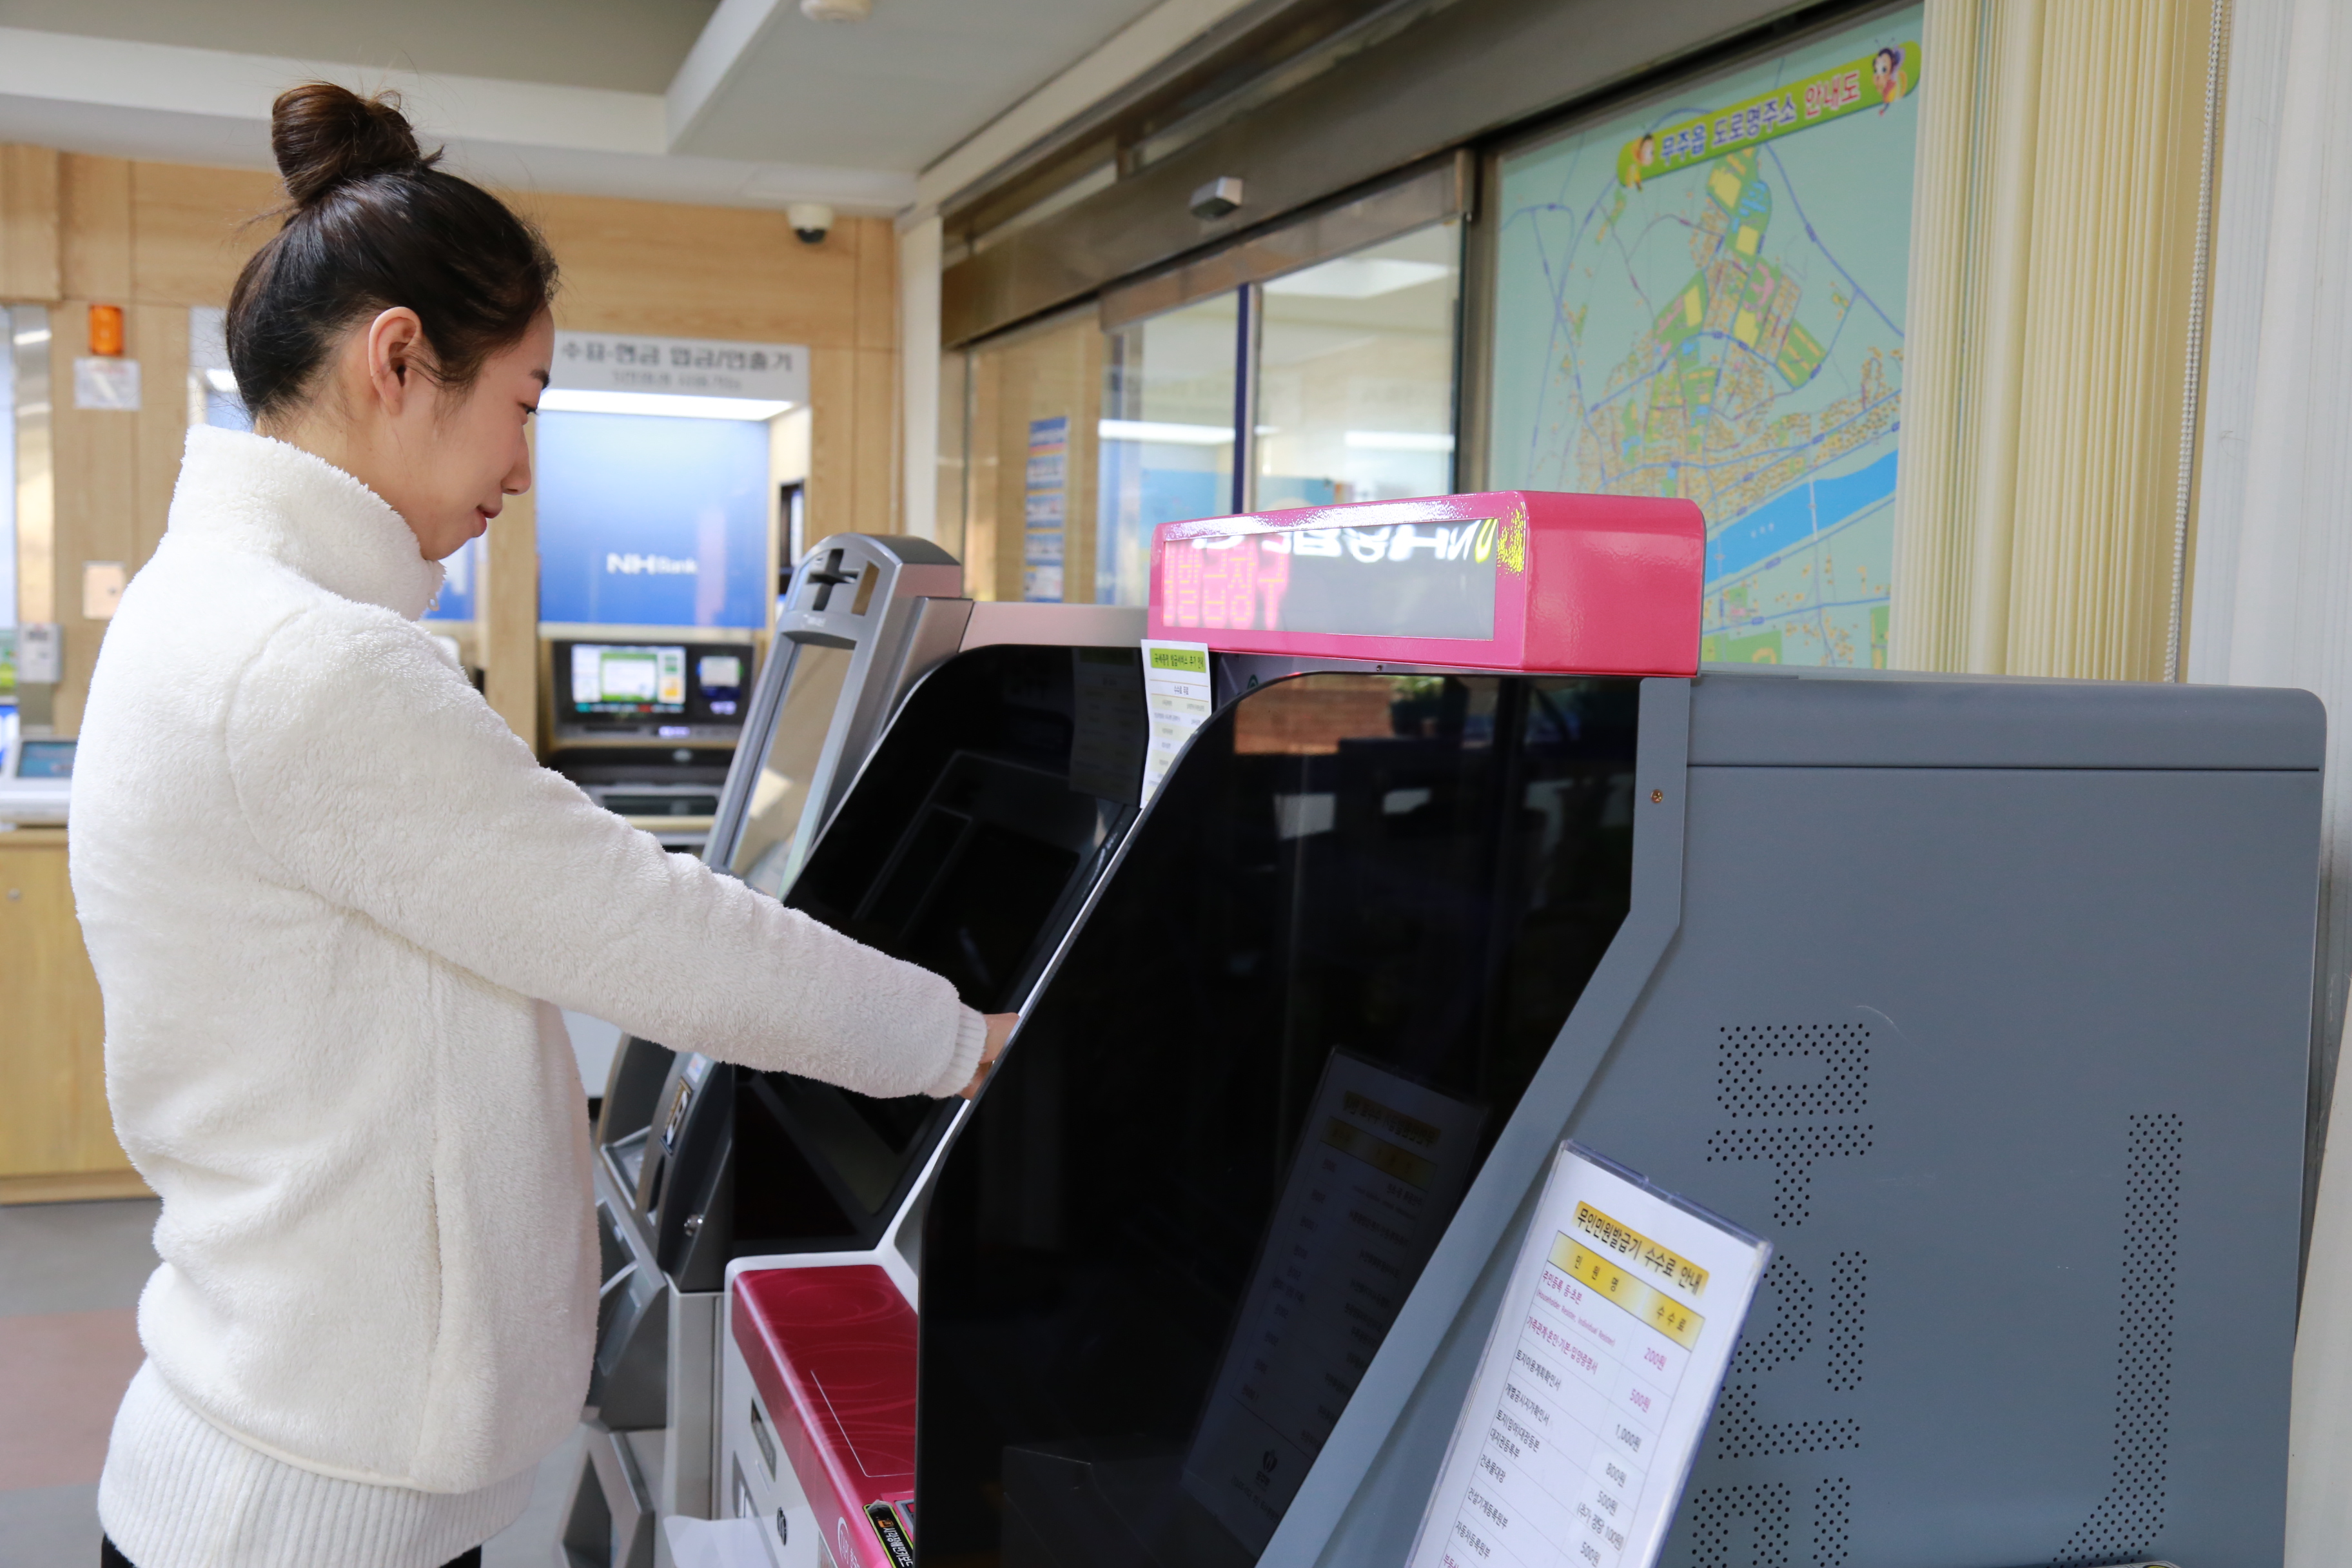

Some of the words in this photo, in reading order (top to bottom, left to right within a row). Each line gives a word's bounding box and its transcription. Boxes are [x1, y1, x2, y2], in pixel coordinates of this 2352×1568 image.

[1660, 124, 1707, 164] 무주읍
[1712, 93, 1797, 148] 도로명주소
[1804, 70, 1861, 119] 안내도
[1577, 1208, 1642, 1260] 무인민원발급기
[1644, 1247, 1676, 1277] 수수료
[1678, 1266, 1703, 1296] 안내
[1542, 1270, 1563, 1293] 주민등록
[1644, 1347, 1667, 1371] 200원
[1515, 1349, 1562, 1392] 토지이용계획확인서
[1616, 1424, 1642, 1453] 1,000원
[1629, 1388, 1652, 1413] 500원
[1489, 1427, 1521, 1460] 대지권등록부
[1505, 1383, 1551, 1427] 개별공시지가확인서
[1605, 1462, 1627, 1488] 800원
[1480, 1454, 1506, 1484] 건축물대장
[1496, 1409, 1540, 1453] 토지(임야)대장등본
[1597, 1490, 1618, 1517] 500원
[1467, 1487, 1509, 1530] 건설기계등록원부
[1455, 1520, 1491, 1560] 자동차등록원부
[1580, 1542, 1602, 1568] 500원
